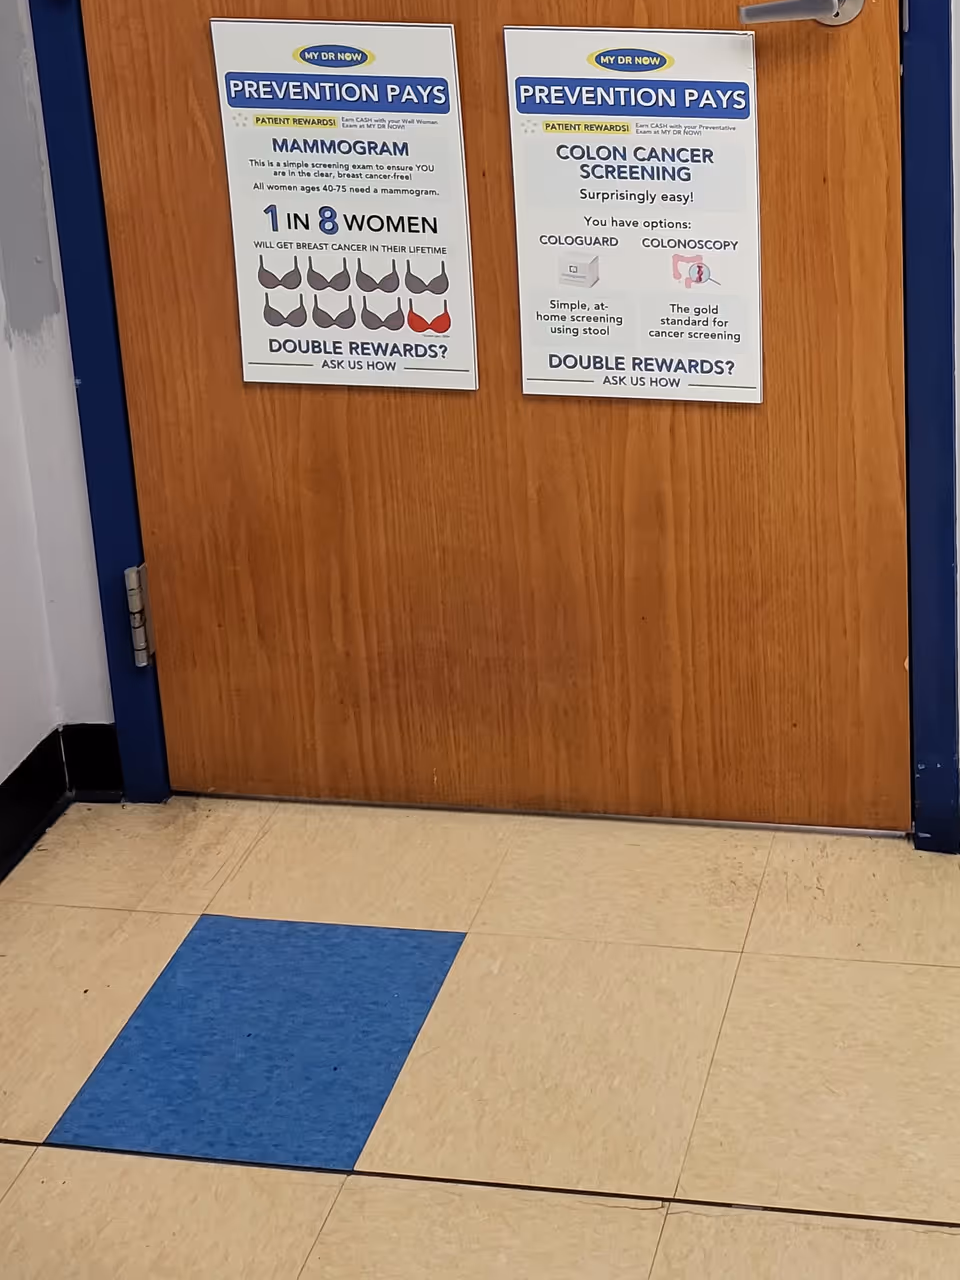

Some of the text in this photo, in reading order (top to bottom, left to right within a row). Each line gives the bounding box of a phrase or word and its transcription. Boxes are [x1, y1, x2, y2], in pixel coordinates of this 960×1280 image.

[305, 51, 362, 61] MY DR NOW
[601, 55, 661, 66] MY DR NOW
[229, 79, 446, 105] PREVENTION PAYS
[519, 85, 747, 110] PREVENTION PAYS
[255, 117, 336, 127] PATIENT REWARDS!
[545, 123, 629, 132] PATIENT REWARDS!
[272, 138, 409, 156] MAMMOGRAM
[556, 144, 714, 164] COLON CANCER
[249, 159, 265, 167] This
[283, 160, 308, 169] simple
[311, 162, 349, 171] screening
[313, 171, 335, 179] clear,
[580, 164, 691, 182] SCREENING
[322, 185, 347, 193] 40-75
[349, 186, 370, 194] need
[380, 188, 439, 197] mammogram.
[580, 188, 694, 205] Surprisingly easy!
[263, 204, 438, 235] 1 IN 8 WOMEN
[583, 216, 692, 232] You have options:
[539, 235, 619, 247] COLOGUARD
[642, 238, 739, 251] COLONOSCOPY
[254, 241, 447, 255] WILL GET BREAST CANCER IN THEIR LIFETIME
[549, 299, 609, 313] Simple, at-
[669, 303, 719, 317] The gold
[536, 312, 623, 326] home screening
[660, 316, 729, 328] standard for
[550, 325, 610, 338] using stool
[648, 329, 741, 342] cancer screening
[269, 338, 448, 359] DOUBLE REWARDS?
[321, 359, 397, 372] ASK US HOW
[549, 353, 735, 376] DOUBLE REWARDS?
[603, 375, 681, 388] ASK US HOW
